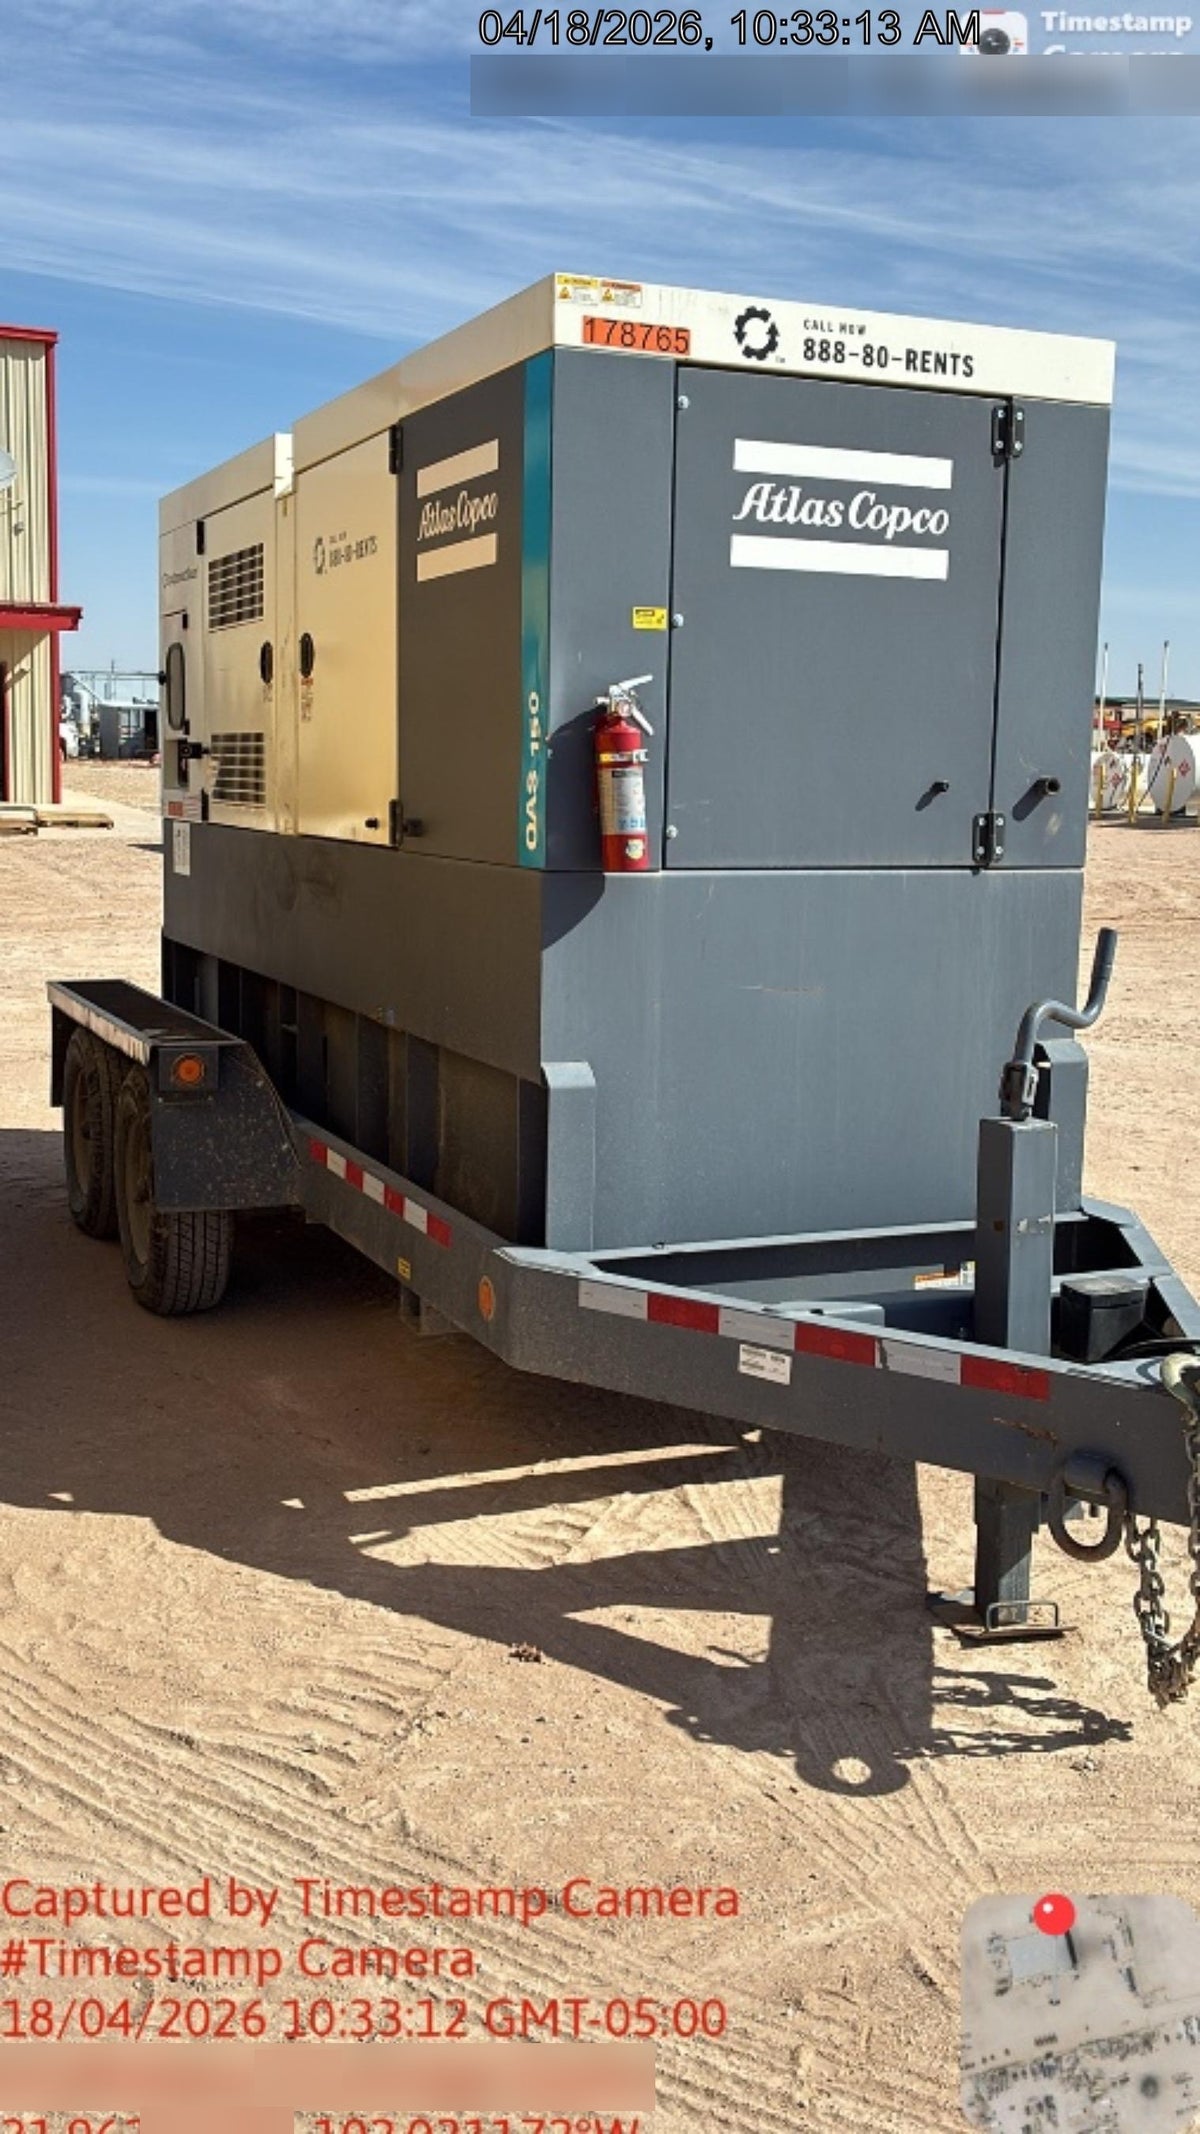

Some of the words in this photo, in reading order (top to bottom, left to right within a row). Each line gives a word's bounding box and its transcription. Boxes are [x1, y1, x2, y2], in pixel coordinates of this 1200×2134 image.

[585, 317, 689, 354] 178765
[803, 318, 834, 333] CALL
[838, 322, 867, 336] NOW
[803, 337, 974, 378] 888-80-RENTS
[417, 500, 456, 541] Atlas
[457, 489, 498, 534] Copco
[732, 482, 845, 528] Atlas
[848, 490, 950, 540] Copco
[528, 690, 542, 757] 150
[525, 769, 539, 851] QAS
